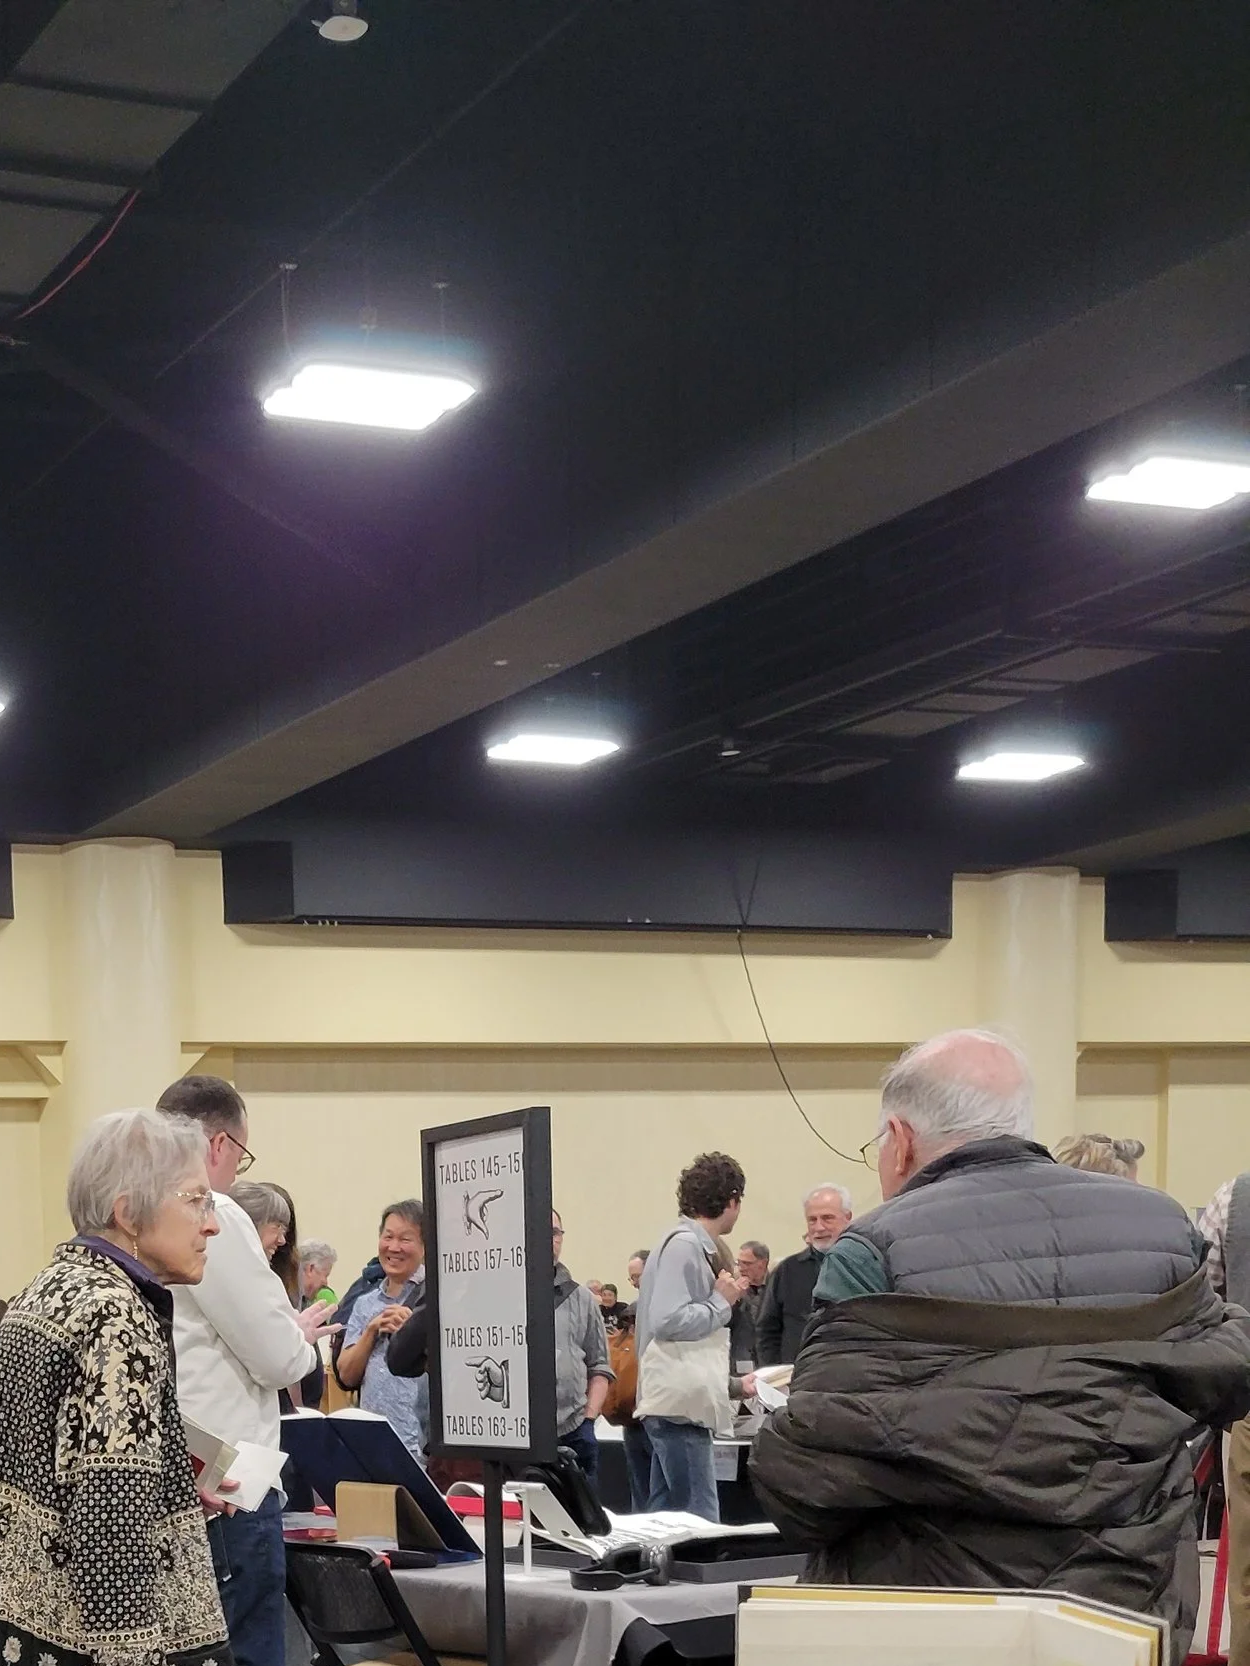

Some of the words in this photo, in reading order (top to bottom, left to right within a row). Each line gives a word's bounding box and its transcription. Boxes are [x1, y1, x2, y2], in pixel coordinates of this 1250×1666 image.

[439, 1159, 477, 1186] TABLES
[481, 1151, 524, 1179] 145-15
[442, 1250, 480, 1274] TABLES
[484, 1245, 526, 1270] 157-16
[445, 1326, 482, 1348] TABLES
[487, 1324, 528, 1347] 151-15
[446, 1415, 484, 1436] TABLES
[488, 1416, 529, 1438] 163-16
